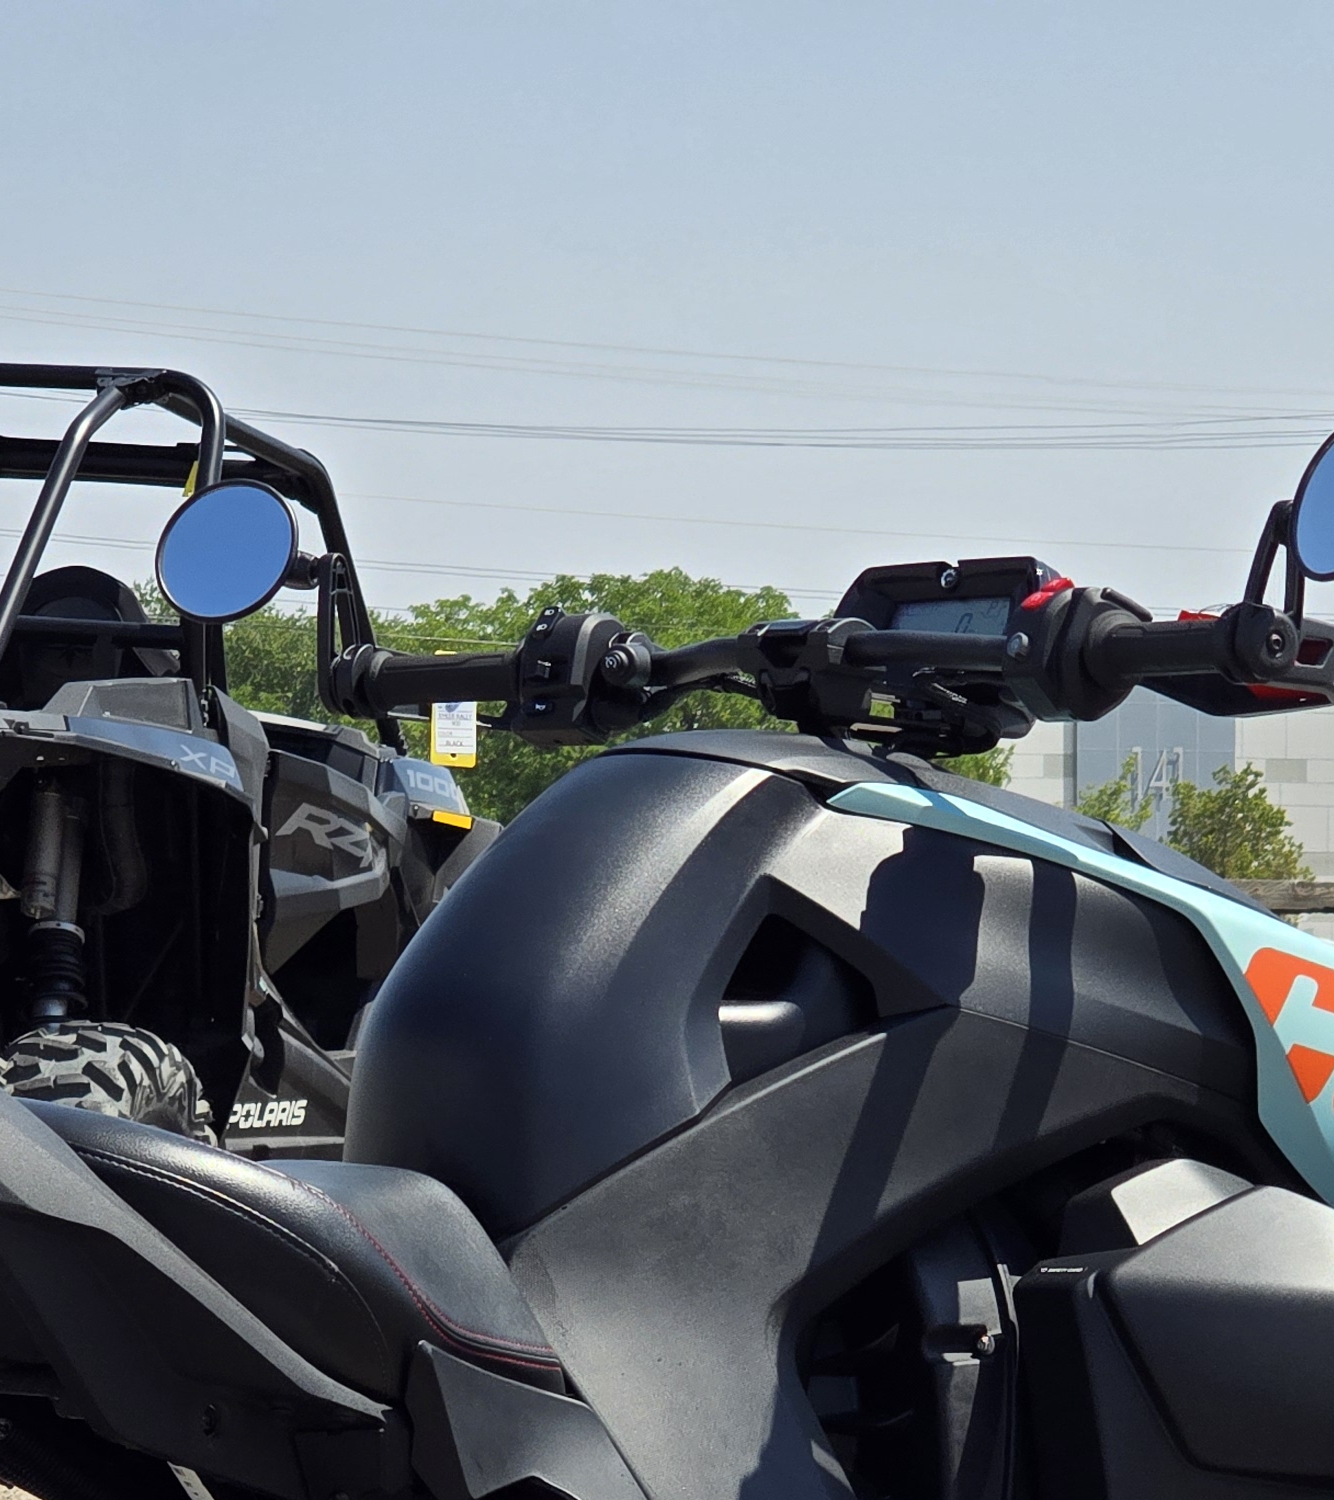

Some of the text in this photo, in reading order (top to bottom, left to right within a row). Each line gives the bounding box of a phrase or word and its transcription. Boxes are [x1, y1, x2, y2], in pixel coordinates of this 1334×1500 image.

[180, 744, 236, 779] XP
[1130, 746, 1184, 801] 141
[225, 1099, 308, 1130] POLARIS
